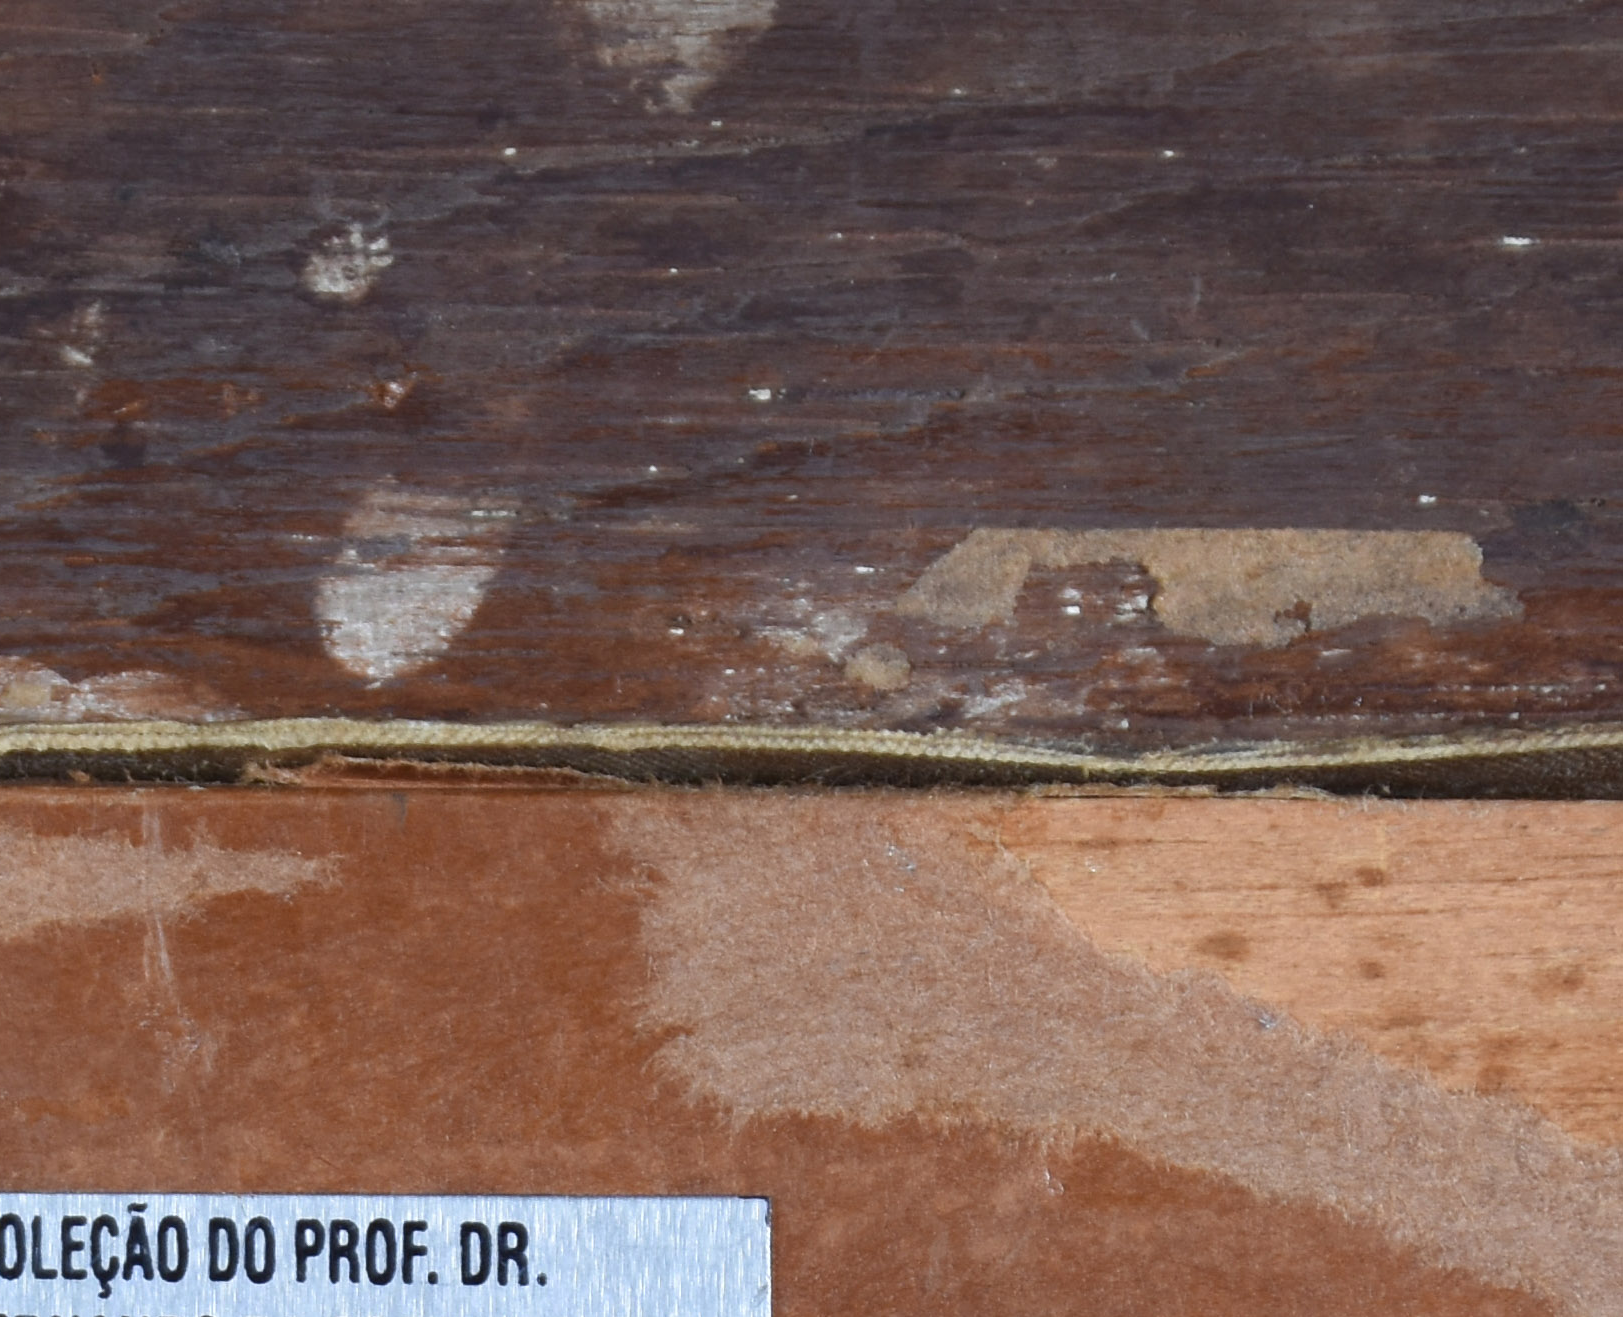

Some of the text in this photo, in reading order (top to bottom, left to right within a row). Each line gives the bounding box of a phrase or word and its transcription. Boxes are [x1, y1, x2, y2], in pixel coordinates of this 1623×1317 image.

[207, 1215, 277, 1285] DO
[293, 1217, 439, 1287] PROF.
[459, 1220, 548, 1287] DR.
